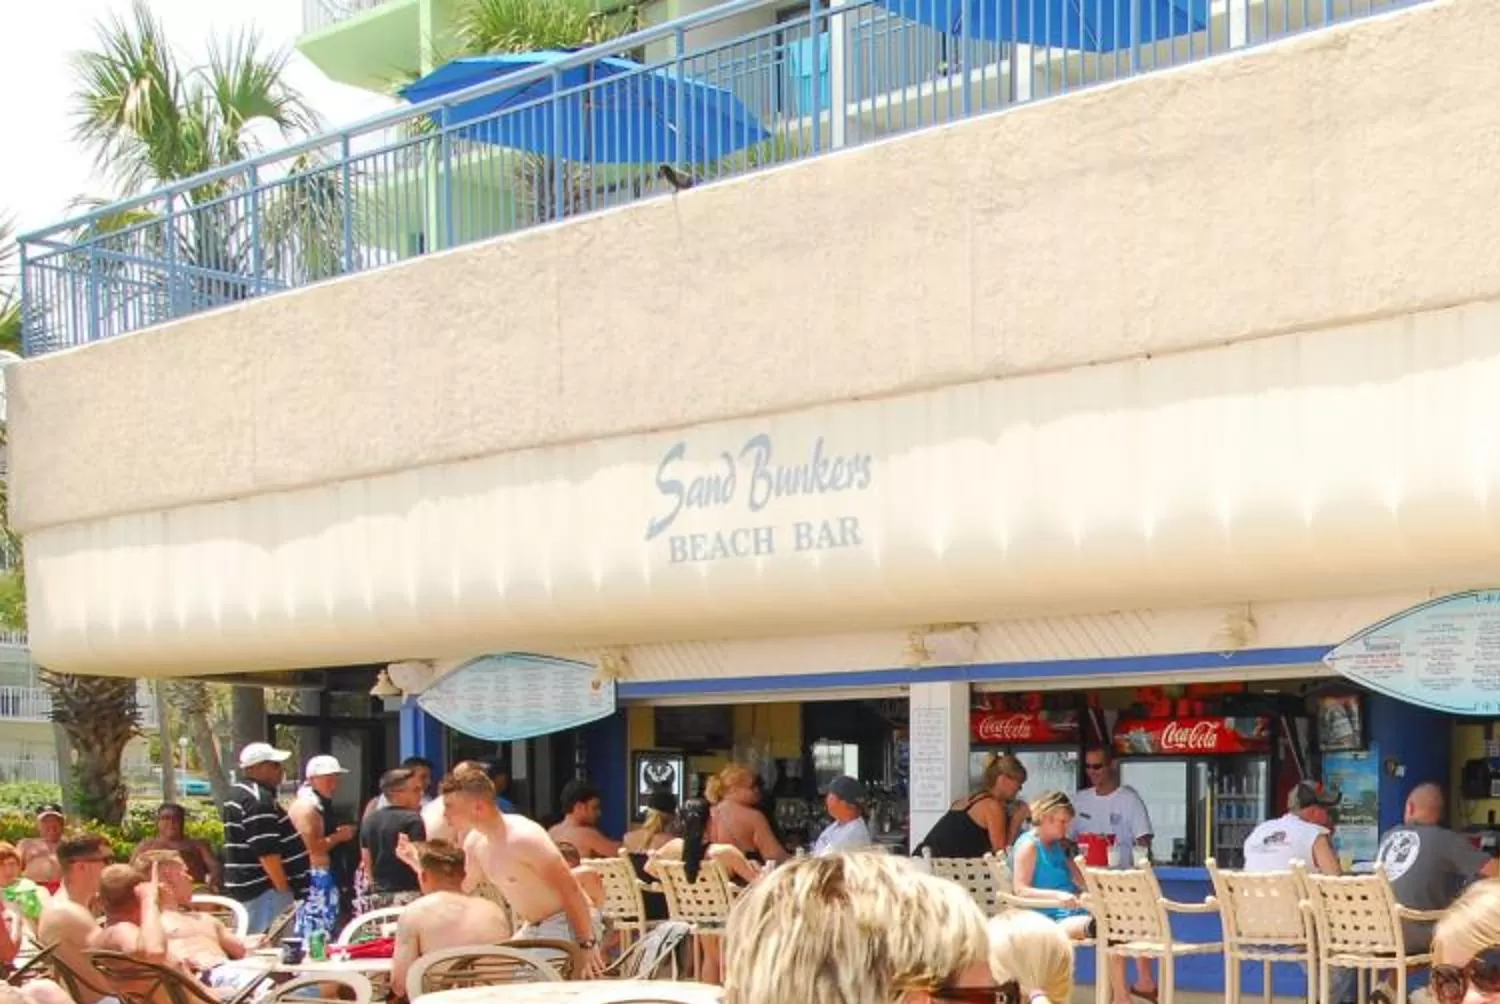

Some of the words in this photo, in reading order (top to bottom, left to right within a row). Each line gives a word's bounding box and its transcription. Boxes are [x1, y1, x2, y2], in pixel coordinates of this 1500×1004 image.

[644, 441, 737, 541] Sand
[739, 433, 872, 512] Bunkers
[668, 526, 775, 563] BEACH
[793, 516, 863, 552] BAR
